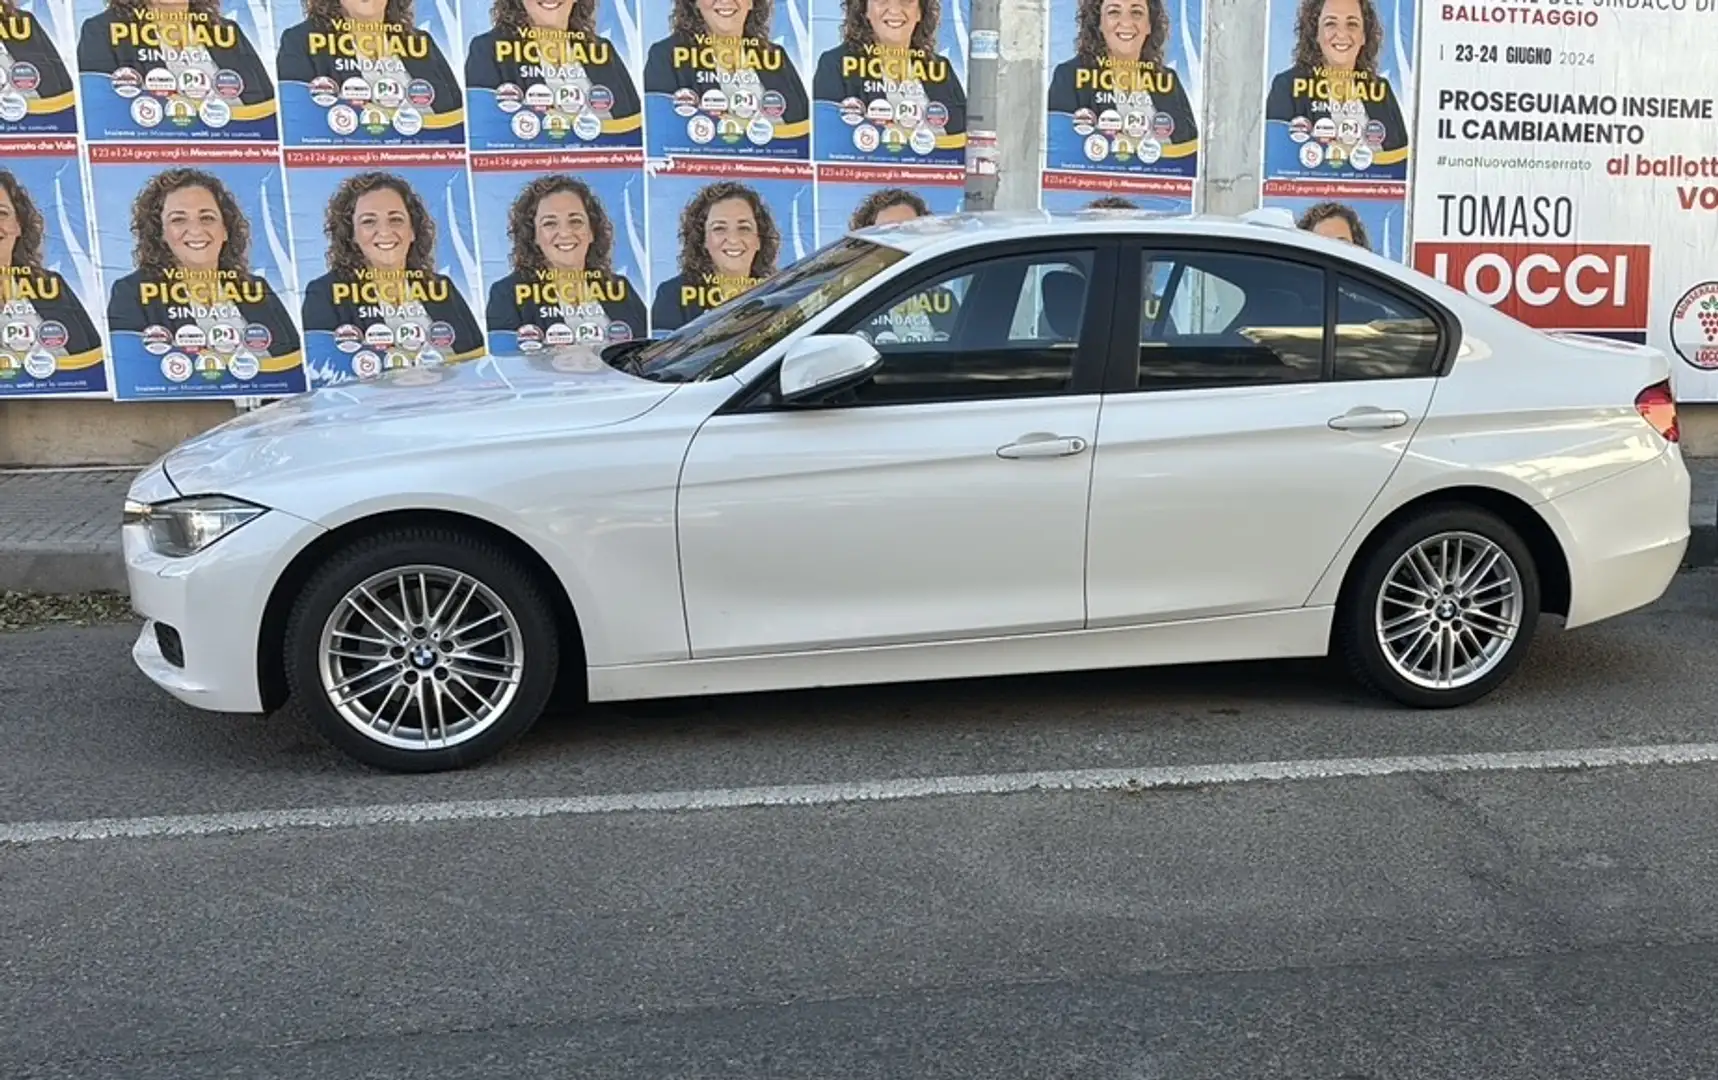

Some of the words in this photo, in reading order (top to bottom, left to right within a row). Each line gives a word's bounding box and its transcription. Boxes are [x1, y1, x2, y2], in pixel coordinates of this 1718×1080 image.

[1696, 0, 1714, 12] DI
[134, 8, 208, 22] Valentina
[1441, 4, 1598, 27] BALLOTTAGGIO
[331, 18, 403, 33] Valentina
[518, 26, 586, 40] Valentina
[110, 22, 237, 48] PICCIAU
[694, 33, 759, 46] Valentina
[308, 32, 428, 59] PICCIAU
[495, 40, 609, 65] PICCIAU
[863, 43, 925, 57] Valentina
[138, 48, 213, 62] SINDACA
[673, 47, 782, 71] PICCIAU
[1454, 44, 1498, 63] 23-24
[1505, 46, 1552, 65] GIUGNO
[1558, 52, 1595, 66] 2024
[335, 58, 406, 73] SINDACA
[842, 56, 946, 82] PICCIAU
[1096, 56, 1154, 71] Valentina
[520, 65, 587, 79] SINDACA
[696, 71, 760, 84] SINDACA
[1312, 66, 1368, 80] Valentina
[863, 80, 925, 94] SINDACA
[1075, 69, 1173, 93] PICCIAU
[1293, 78, 1386, 102] PICCIAU
[1095, 92, 1153, 105] SINDACA
[1438, 90, 1617, 116] PROSEGUIAMO
[1622, 96, 1714, 119] INSIEME
[1310, 100, 1364, 114] SINDACA
[1438, 118, 1456, 139] IL
[1460, 119, 1645, 145] CAMBIAMENTO
[1436, 156, 1593, 171] #unaNuovaMonserrato
[1606, 153, 1630, 176] al
[1676, 186, 1718, 210] VO
[1437, 194, 1573, 239] TOMASO
[164, 267, 237, 281] Valentina
[354, 267, 424, 281] Valentina
[535, 269, 602, 281] Valentina
[139, 280, 264, 306] PICCIAU
[332, 280, 448, 306] PICCIAU
[514, 279, 626, 306] PICCIAU
[681, 286, 738, 307] PICC
[167, 306, 242, 320] SINDACA
[358, 305, 427, 319] SINDACA
[539, 305, 605, 319] SINDACA
